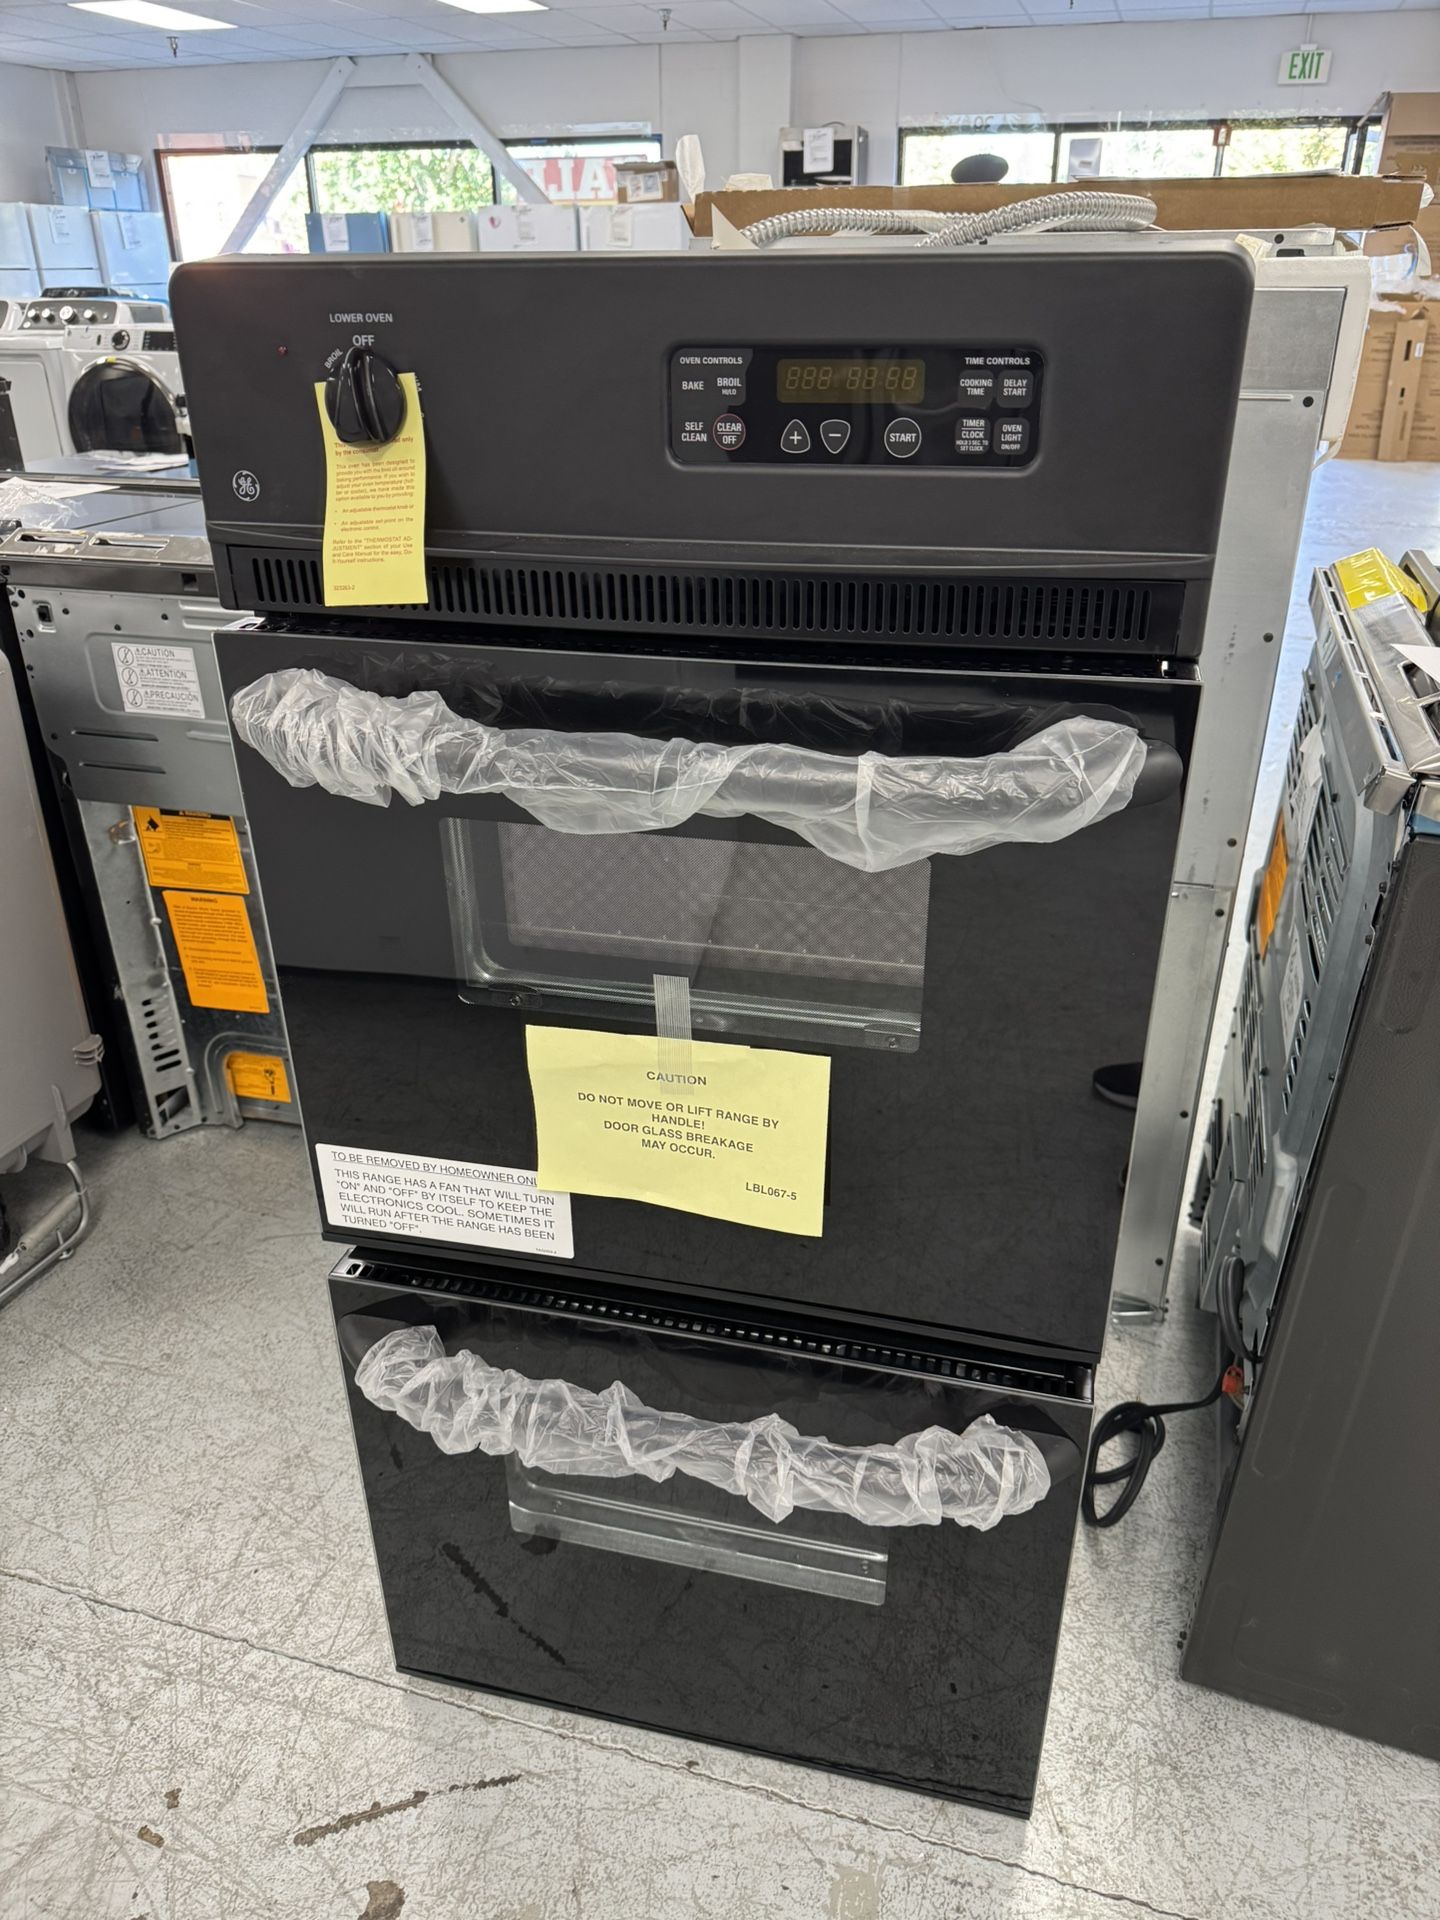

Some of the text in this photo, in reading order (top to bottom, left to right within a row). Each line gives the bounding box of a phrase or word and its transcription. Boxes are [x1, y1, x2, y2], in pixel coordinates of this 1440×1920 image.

[1288, 52, 1324, 80] EXIT
[329, 313, 393, 323] LOWER OVEN
[352, 335, 374, 346] OFF
[324, 348, 343, 369] BROIL
[682, 382, 704, 390] BAKE
[717, 378, 742, 387] BROIL
[960, 379, 992, 387] COOKING
[1004, 379, 1027, 387] DELAY
[1003, 388, 1026, 396] START
[685, 422, 703, 431] SELF
[717, 423, 742, 432] CLEAR
[963, 419, 985, 427] TIMER
[1002, 424, 1022, 432] OVEN
[682, 433, 707, 442] CLEAN
[723, 435, 737, 444] OFF
[890, 433, 916, 442] START
[962, 431, 984, 439] CLOCK
[141, 648, 175, 658] CAUTION
[147, 670, 187, 679] ATTENTION
[150, 690, 199, 702] PRECAUCIÓN
[646, 1071, 707, 1085] CAUTION
[578, 1092, 779, 1129] DO NOT MOVE OR LIFT RANGE BY
[652, 1114, 704, 1130] HANDLE!
[604, 1121, 753, 1152] DOOR GLASS BREAKAGE
[642, 1139, 715, 1159] MAY OCCUR.
[332, 1151, 538, 1186] TO BE REMOVED BY HOMEOWNER ONL
[334, 1168, 555, 1205] THIS RANGE HAS A FAN THAT WILL TURN
[746, 1182, 797, 1200] LBL067-5
[337, 1180, 552, 1217] "ON" AND "OFF" BY ITSELF TO KEEP THE
[339, 1192, 423, 1211] ELECTRONICS
[468, 1209, 540, 1227] SOMETIMES
[544, 1220, 555, 1228] IT
[340, 1203, 555, 1240] WILL RUN AFTER THE RANGE HAS BEEN
[342, 1214, 422, 1233] TURNED "OFF".
